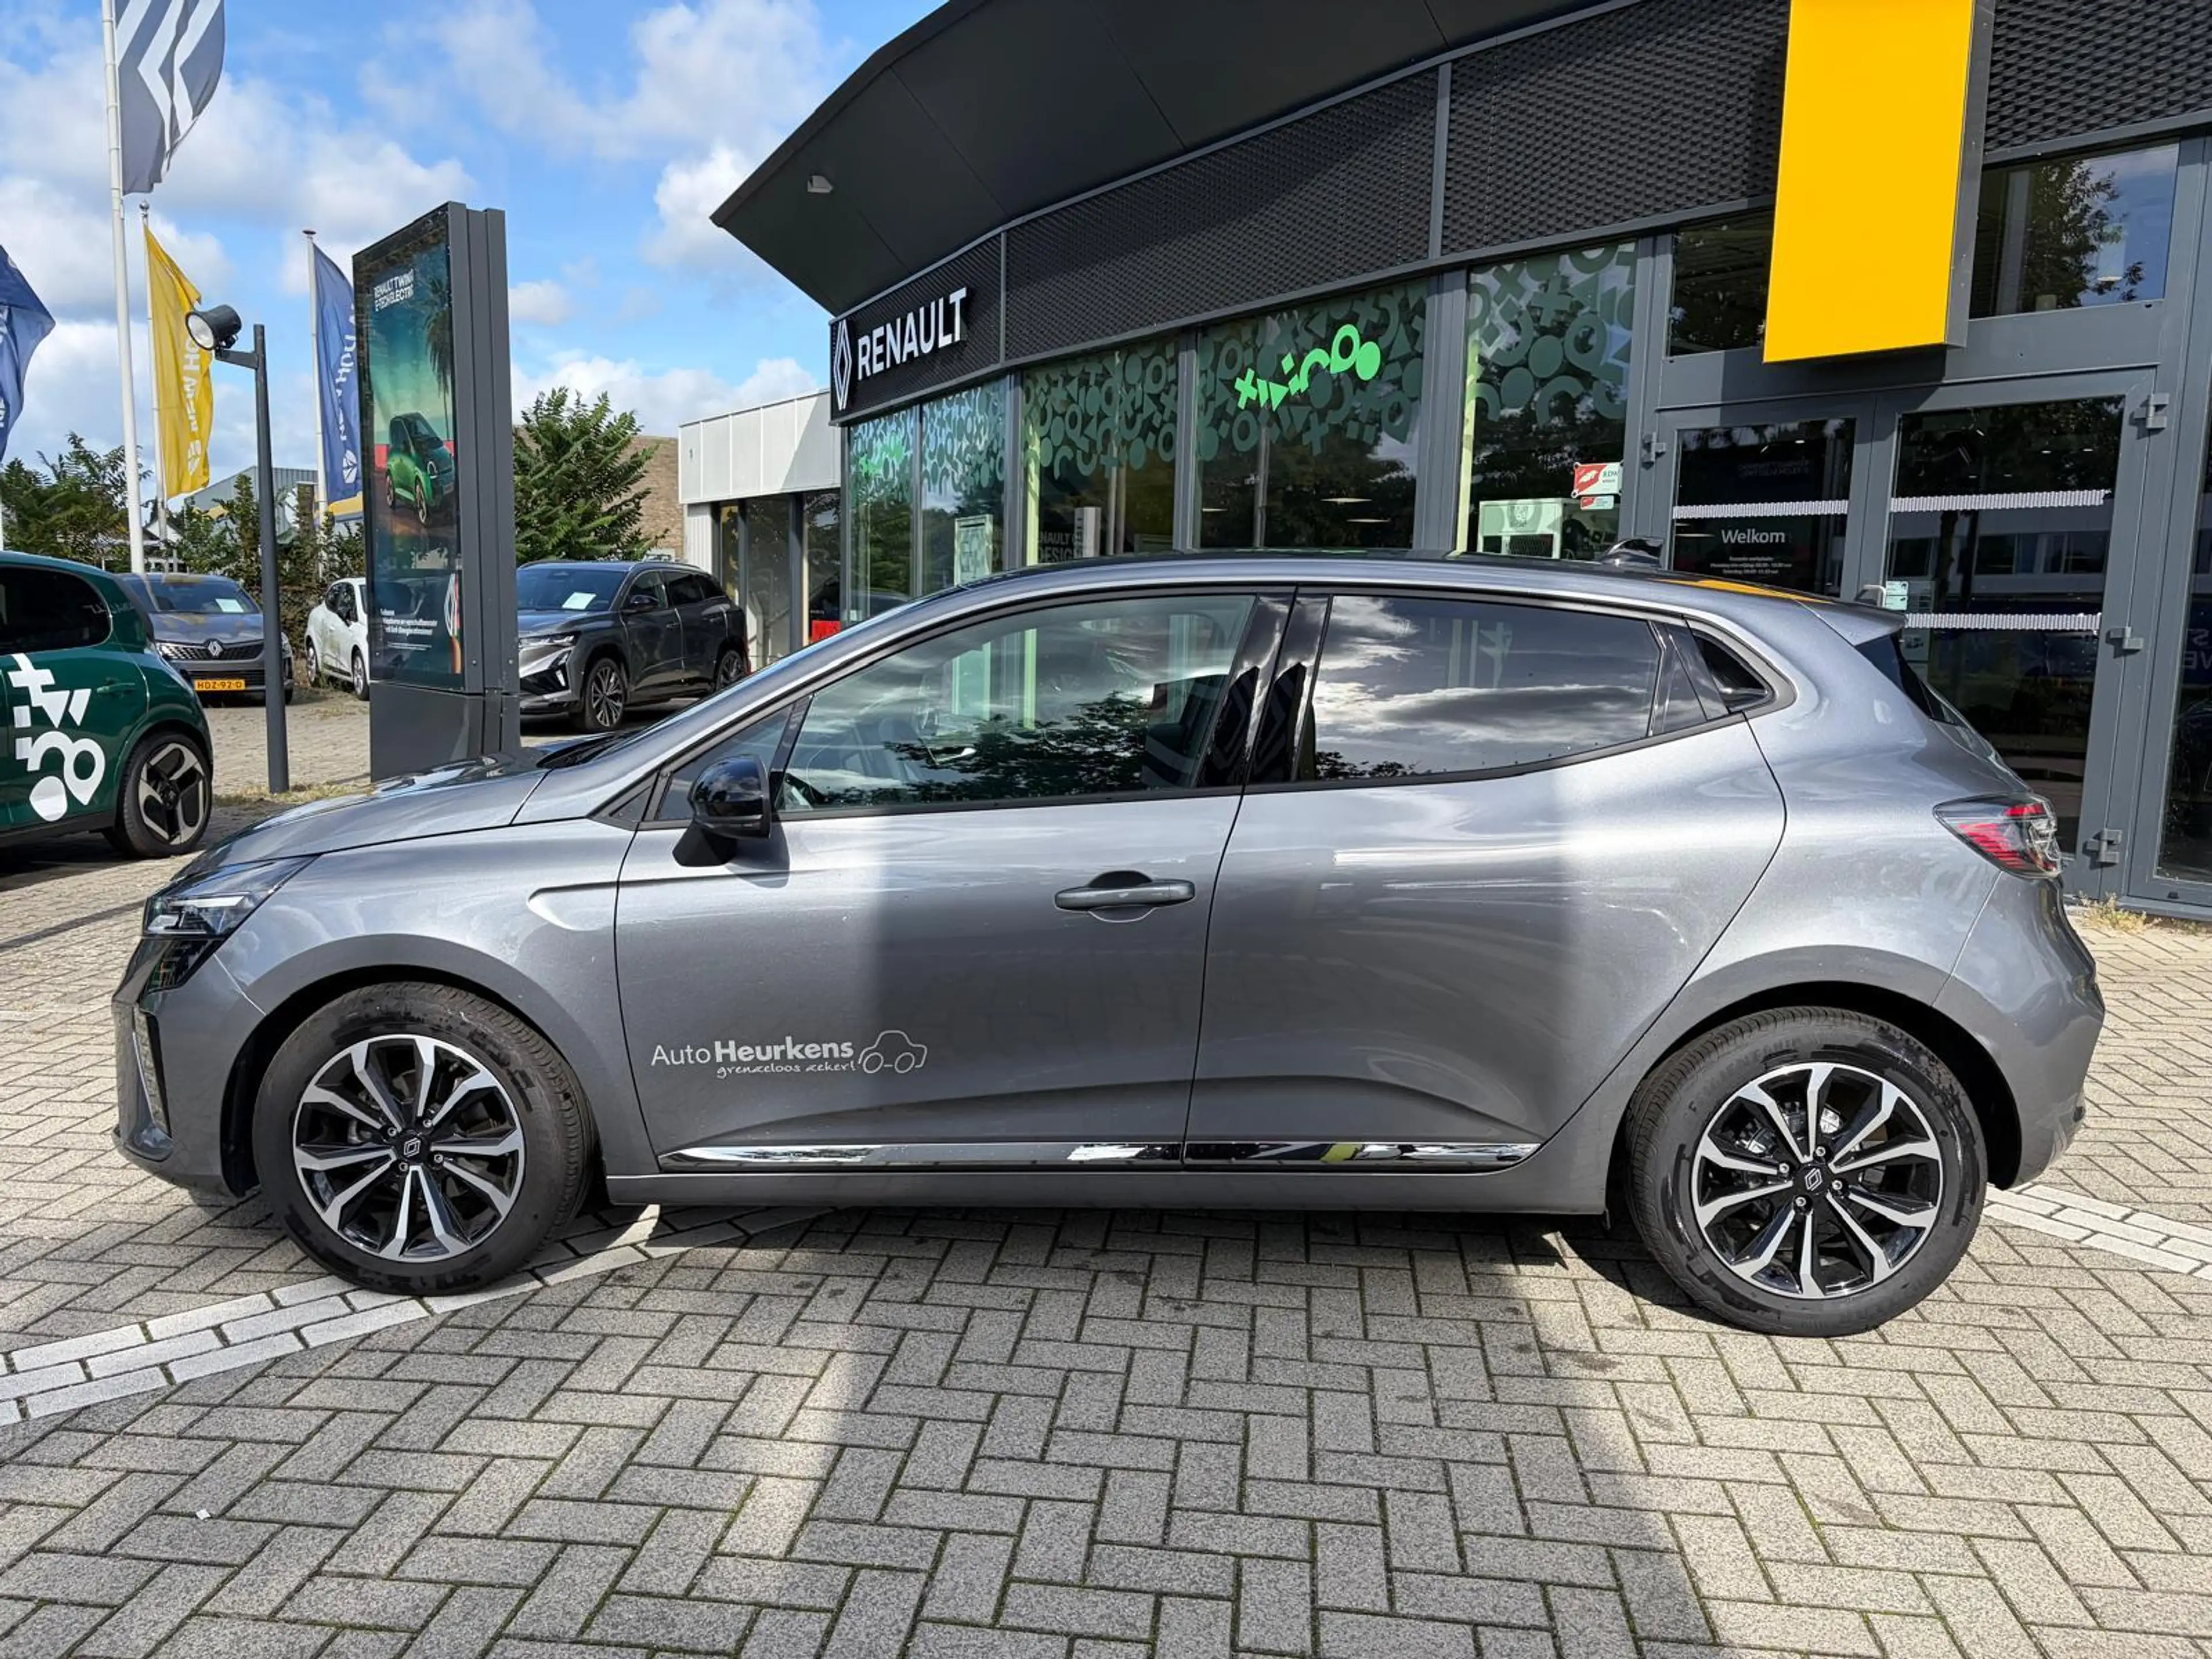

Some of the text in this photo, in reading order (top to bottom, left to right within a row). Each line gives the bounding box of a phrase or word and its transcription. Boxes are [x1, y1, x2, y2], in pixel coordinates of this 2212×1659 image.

[858, 287, 967, 381] RENAULT
[1721, 528, 1786, 543] Welkom
[651, 1036, 854, 1066] Auto Heurkens
[717, 1059, 855, 1080] grenzeloos zeker!
